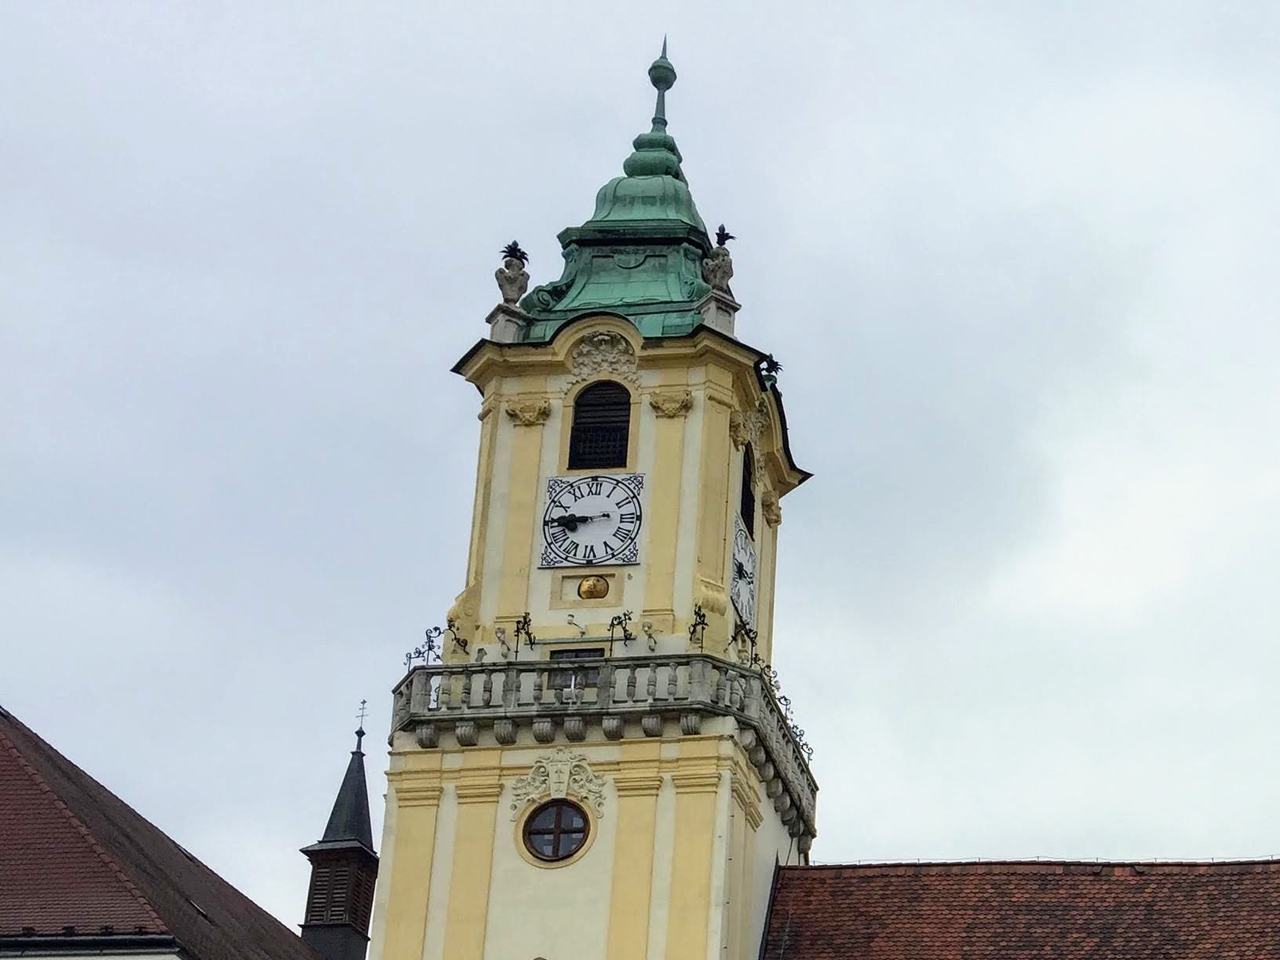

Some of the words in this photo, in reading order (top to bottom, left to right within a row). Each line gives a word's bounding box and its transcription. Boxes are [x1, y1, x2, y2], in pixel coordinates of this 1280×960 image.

[568, 485, 585, 503] XI
[587, 482, 603, 496] XII
[606, 486, 617, 498] I
[555, 500, 571, 513] X
[615, 496, 632, 509] II
[620, 512, 635, 524] III
[583, 545, 597, 559] VI
[603, 541, 615, 554] V
